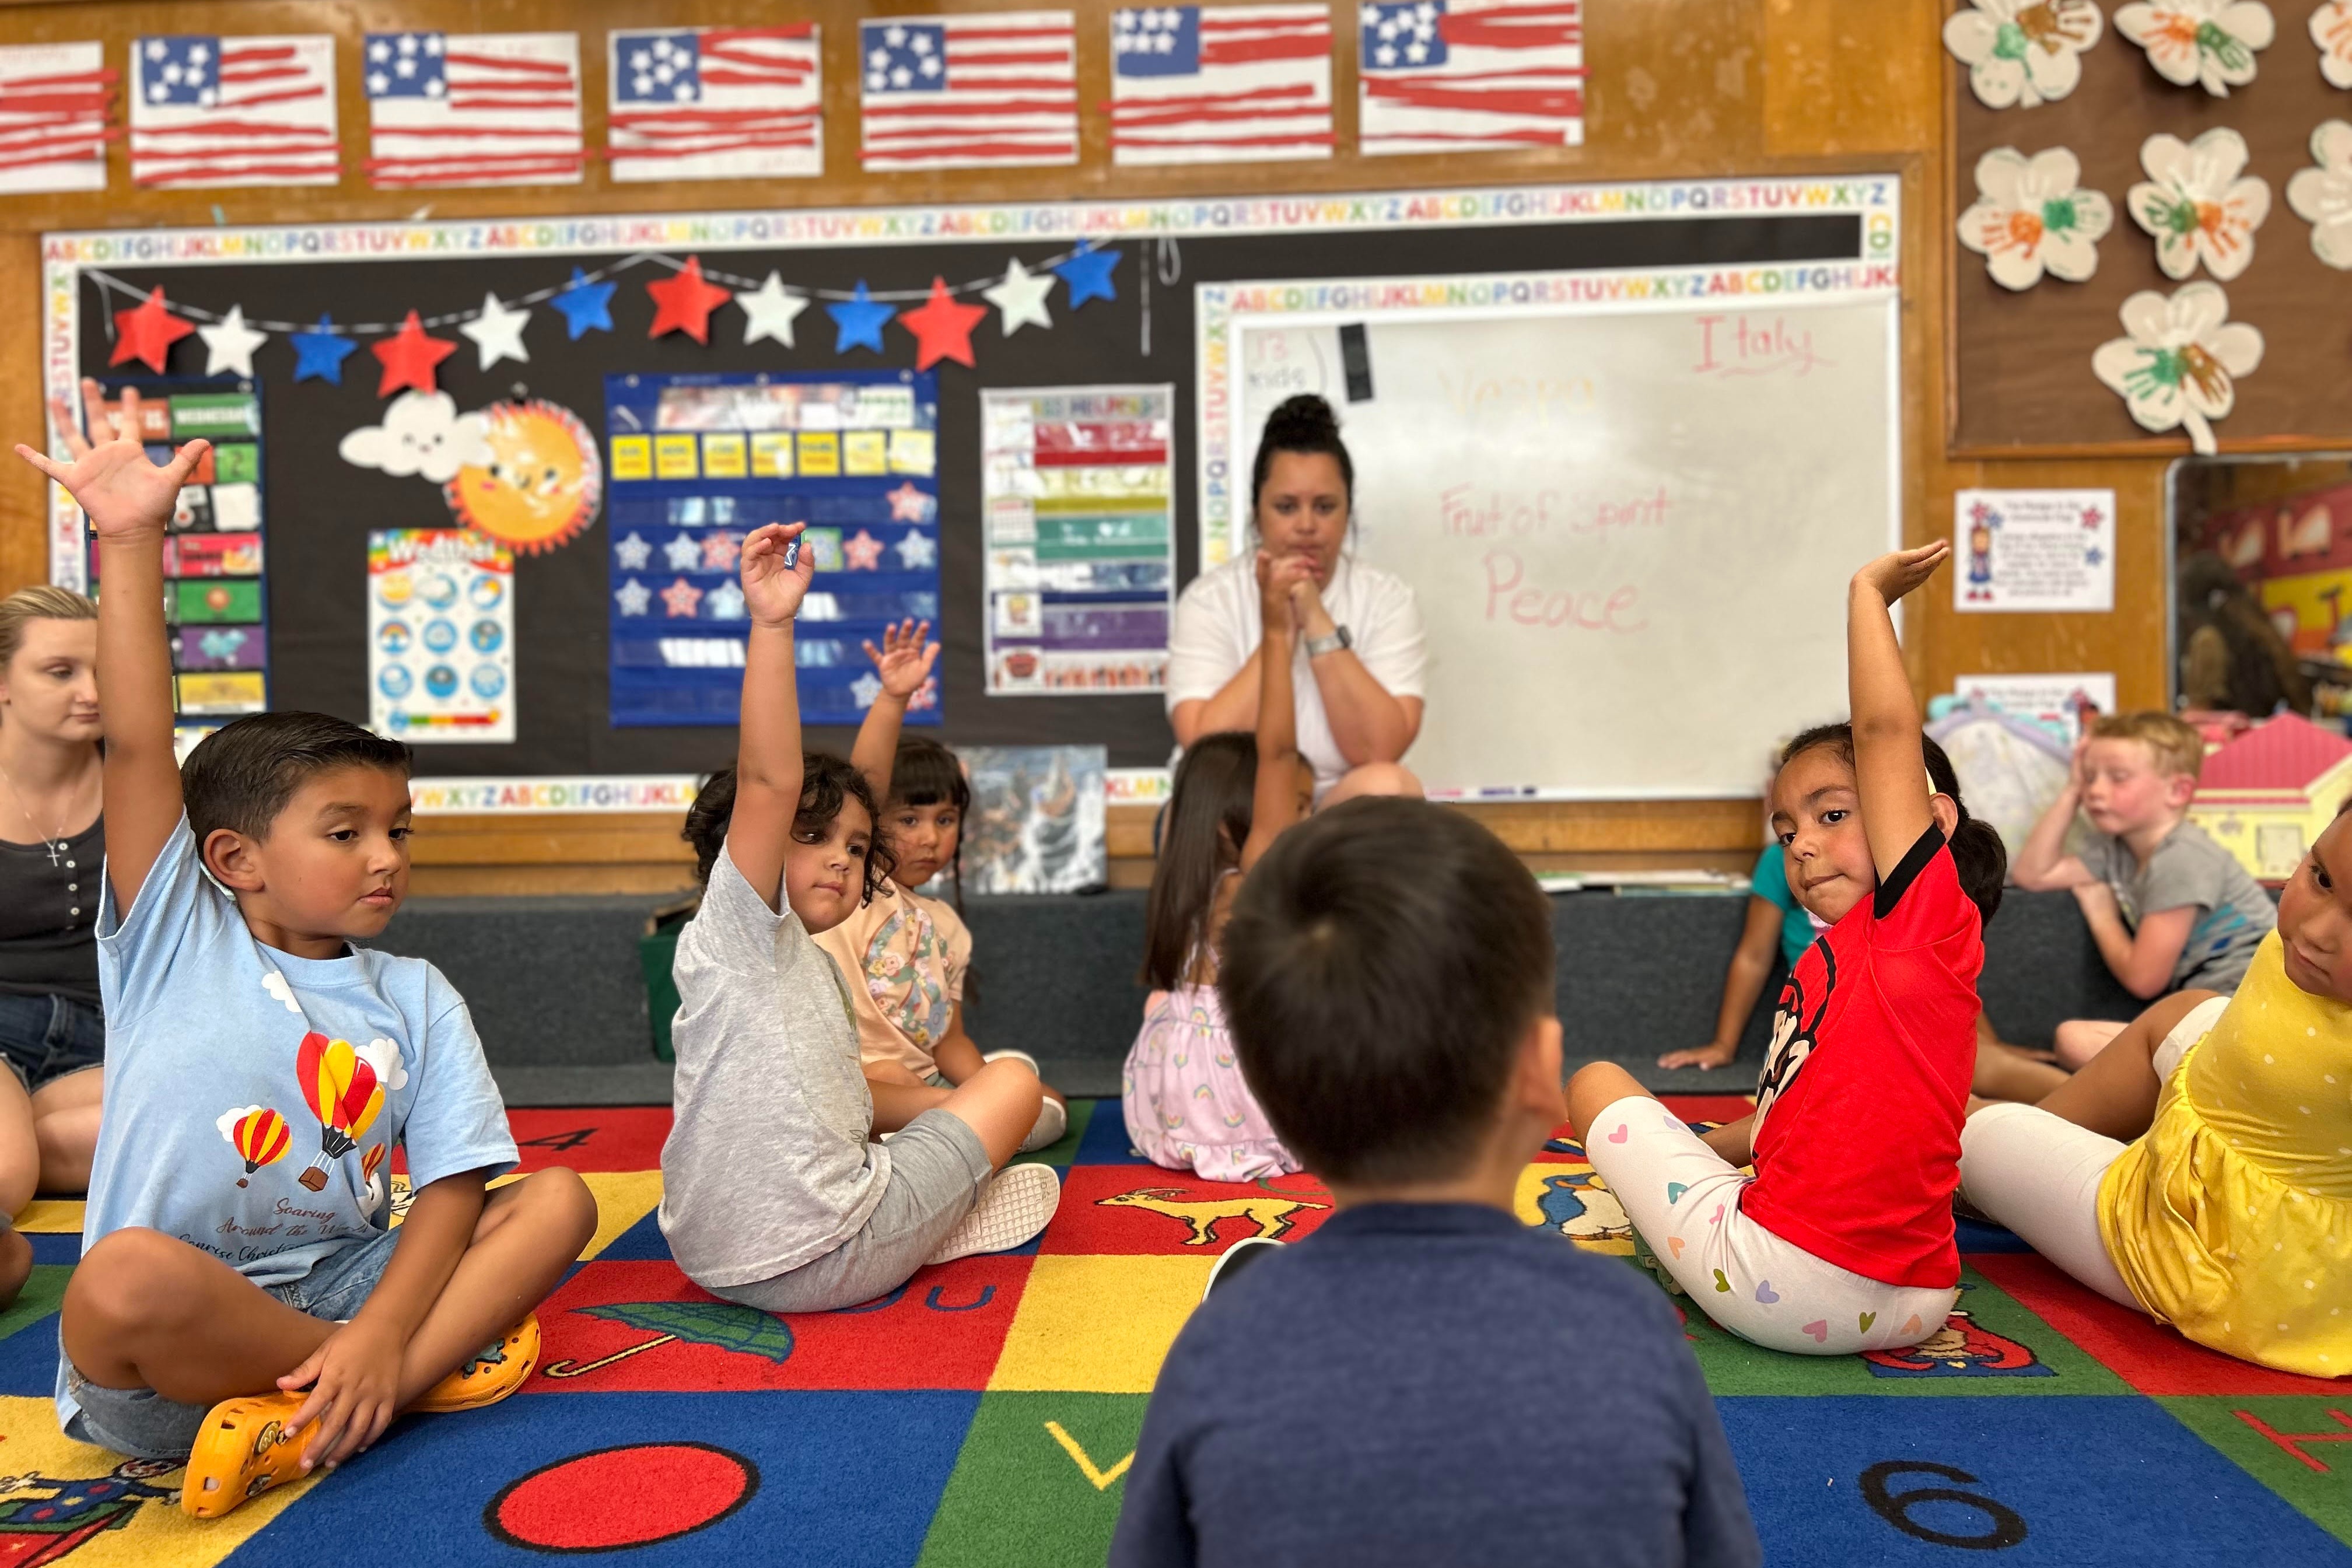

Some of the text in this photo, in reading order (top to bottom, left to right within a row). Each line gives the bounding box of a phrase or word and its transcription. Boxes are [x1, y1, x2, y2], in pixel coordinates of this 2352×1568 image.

[1690, 314, 1812, 378] Italy
[1510, 488, 1561, 535] of
[1482, 547, 1650, 635] Peace
[517, 1128, 599, 1152] 4
[216, 1217, 284, 1237] Around
[273, 1198, 337, 1224] Soaring
[1859, 1460, 2028, 1550] 6
